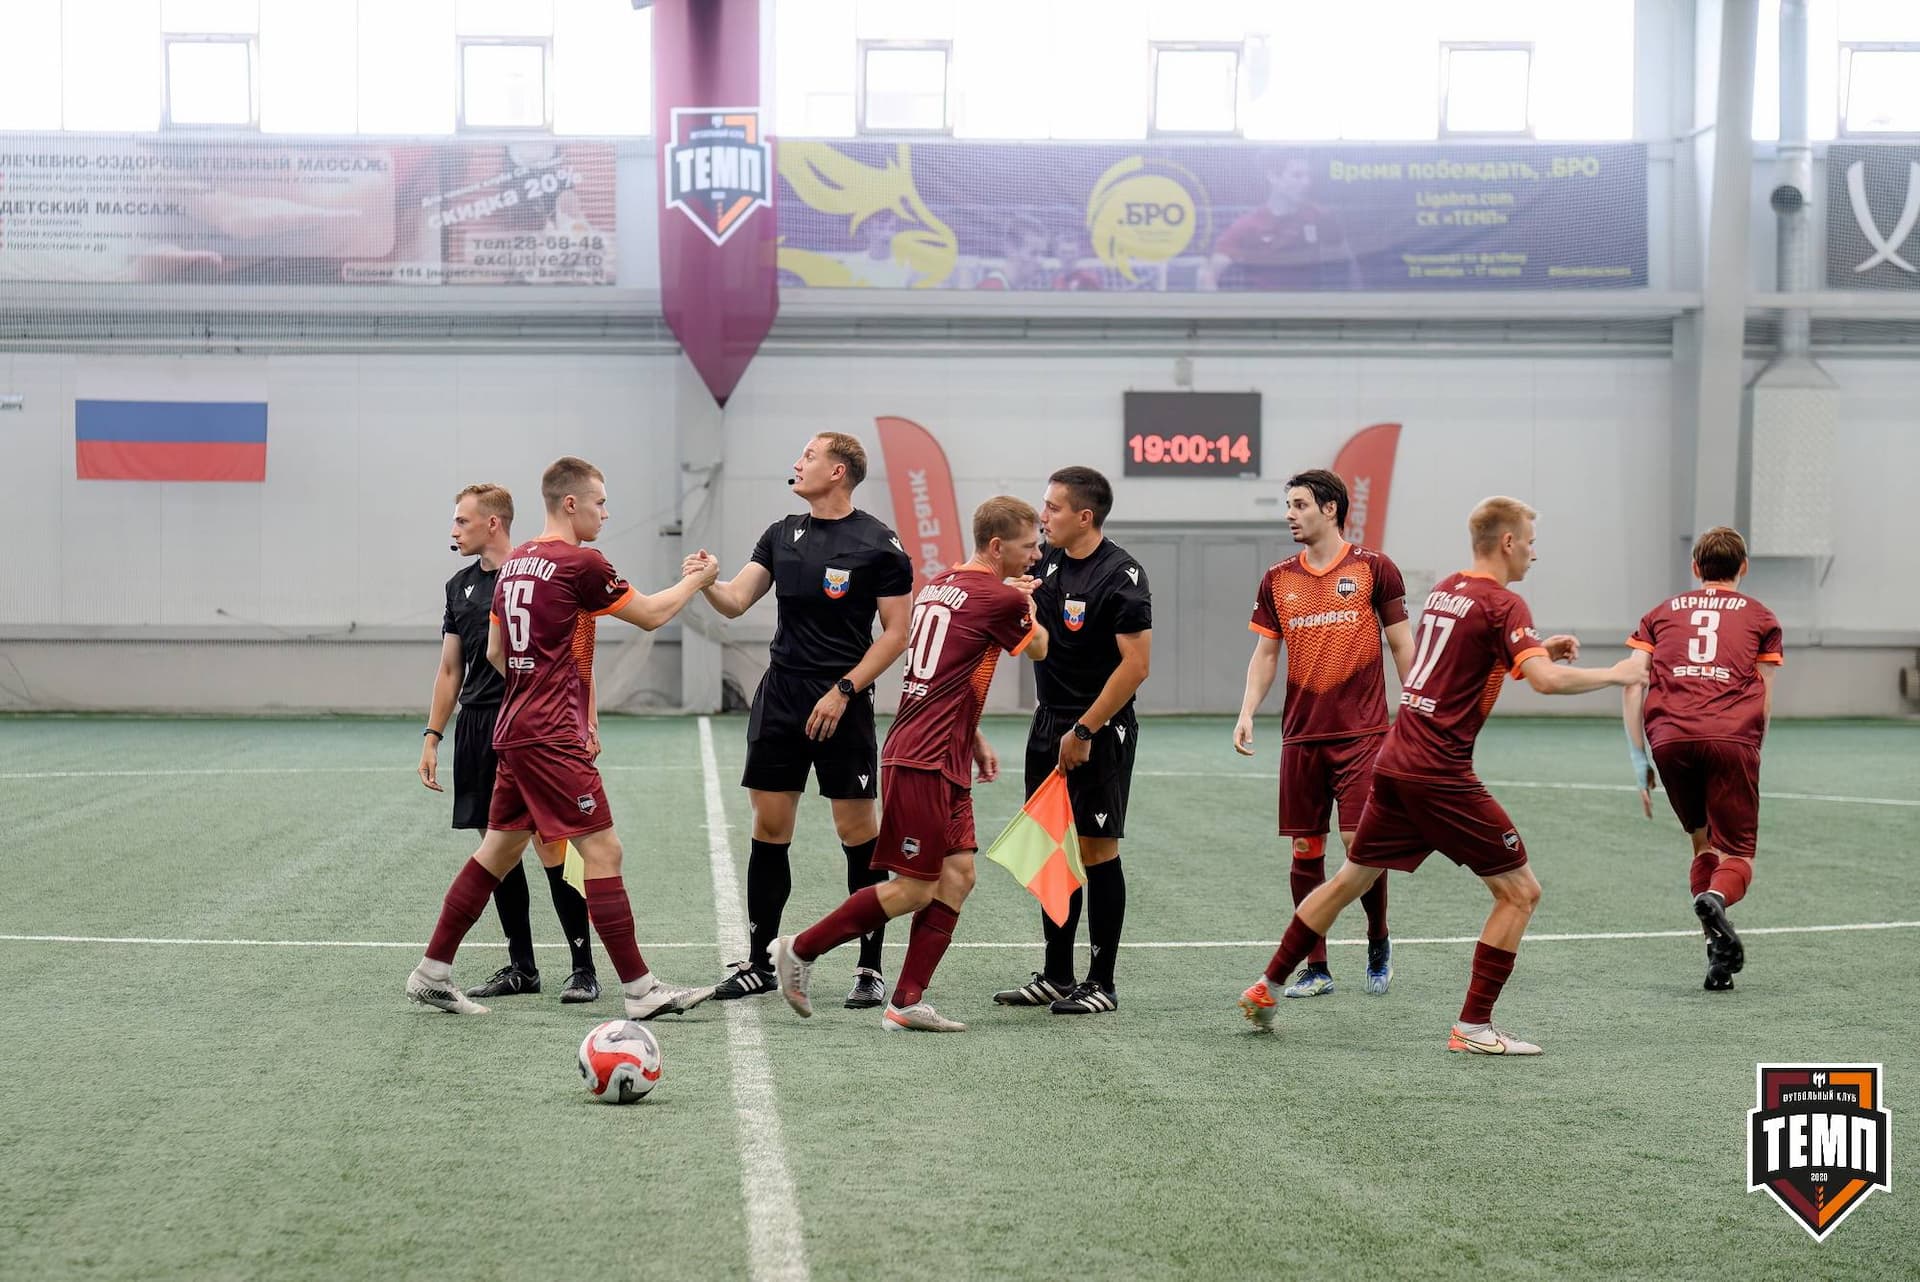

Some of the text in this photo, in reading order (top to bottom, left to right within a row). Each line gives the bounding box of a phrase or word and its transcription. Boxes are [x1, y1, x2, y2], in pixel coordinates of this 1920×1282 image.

[0, 153, 290, 170] ЛЕЧЕБНО-ОЗДОРОВИТЕЛЬНЫЙ
[675, 146, 761, 192] ТЕМП
[1330, 160, 1402, 182] Время
[524, 165, 583, 198] 20%
[0, 200, 187, 216] ДЕТСКИЙ МАССАЖ:
[1117, 203, 1186, 226] .БРО
[1128, 434, 1251, 464] 19:00:14
[503, 580, 535, 652] 15
[1671, 596, 1748, 611] ВЕРНИГОР
[1688, 610, 1720, 663] 3
[1404, 613, 1457, 690] 17
[1673, 665, 1730, 679] SEUS
